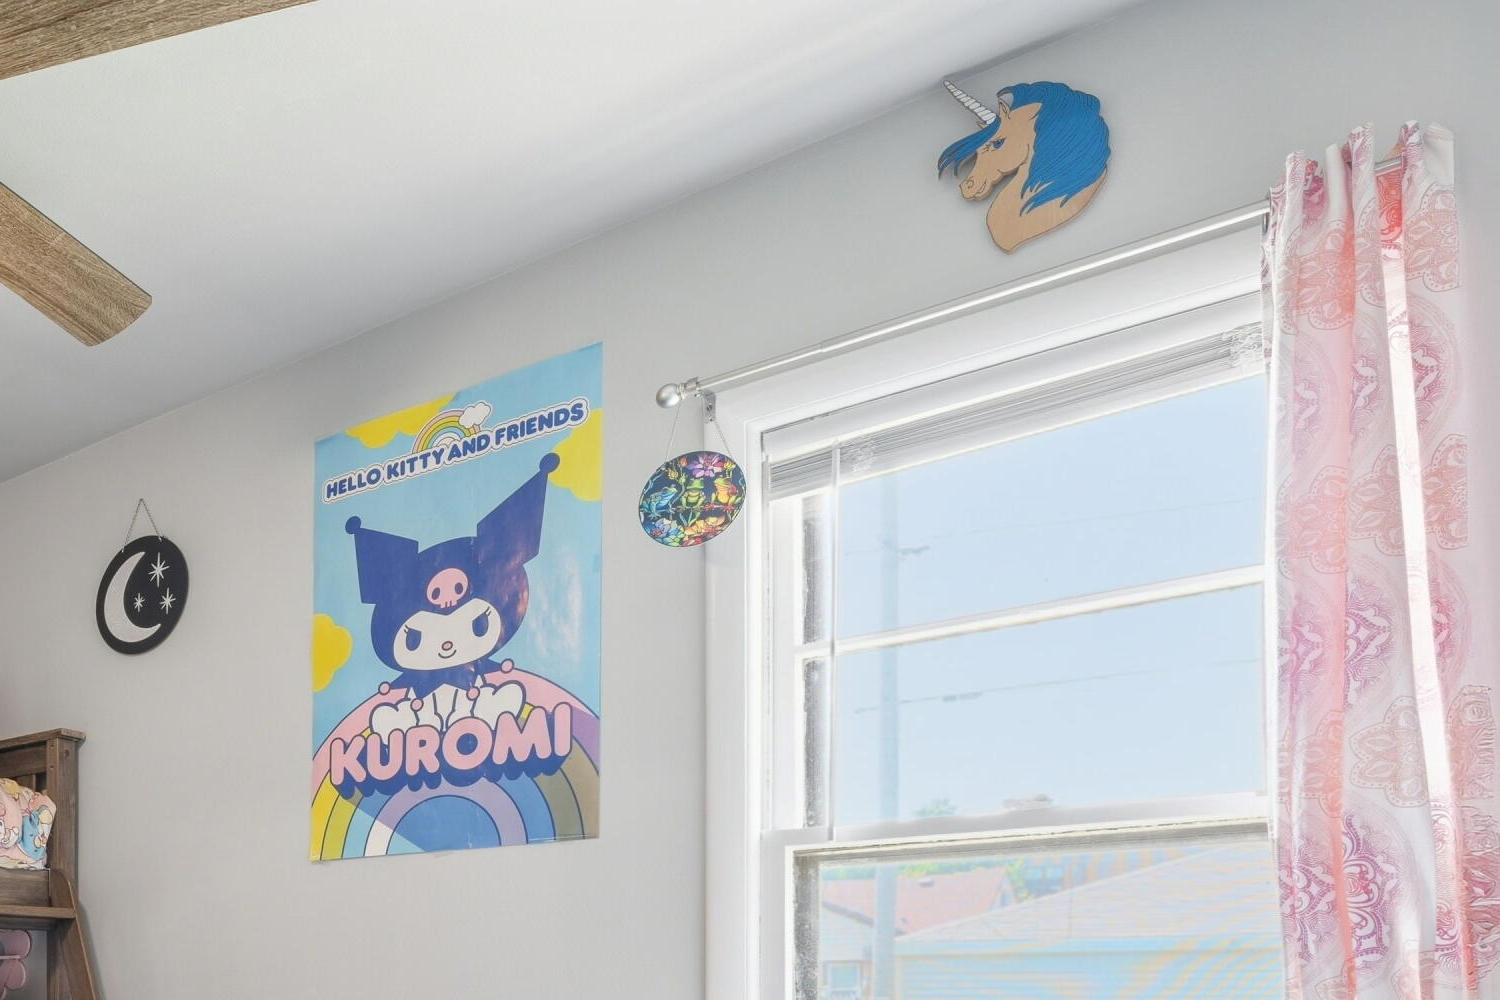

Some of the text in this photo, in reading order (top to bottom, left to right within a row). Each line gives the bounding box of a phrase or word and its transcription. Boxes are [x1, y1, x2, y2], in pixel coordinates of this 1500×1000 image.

[326, 402, 584, 500] HELLO KITTY AND FRIENDS
[329, 702, 573, 788] KUROMI
